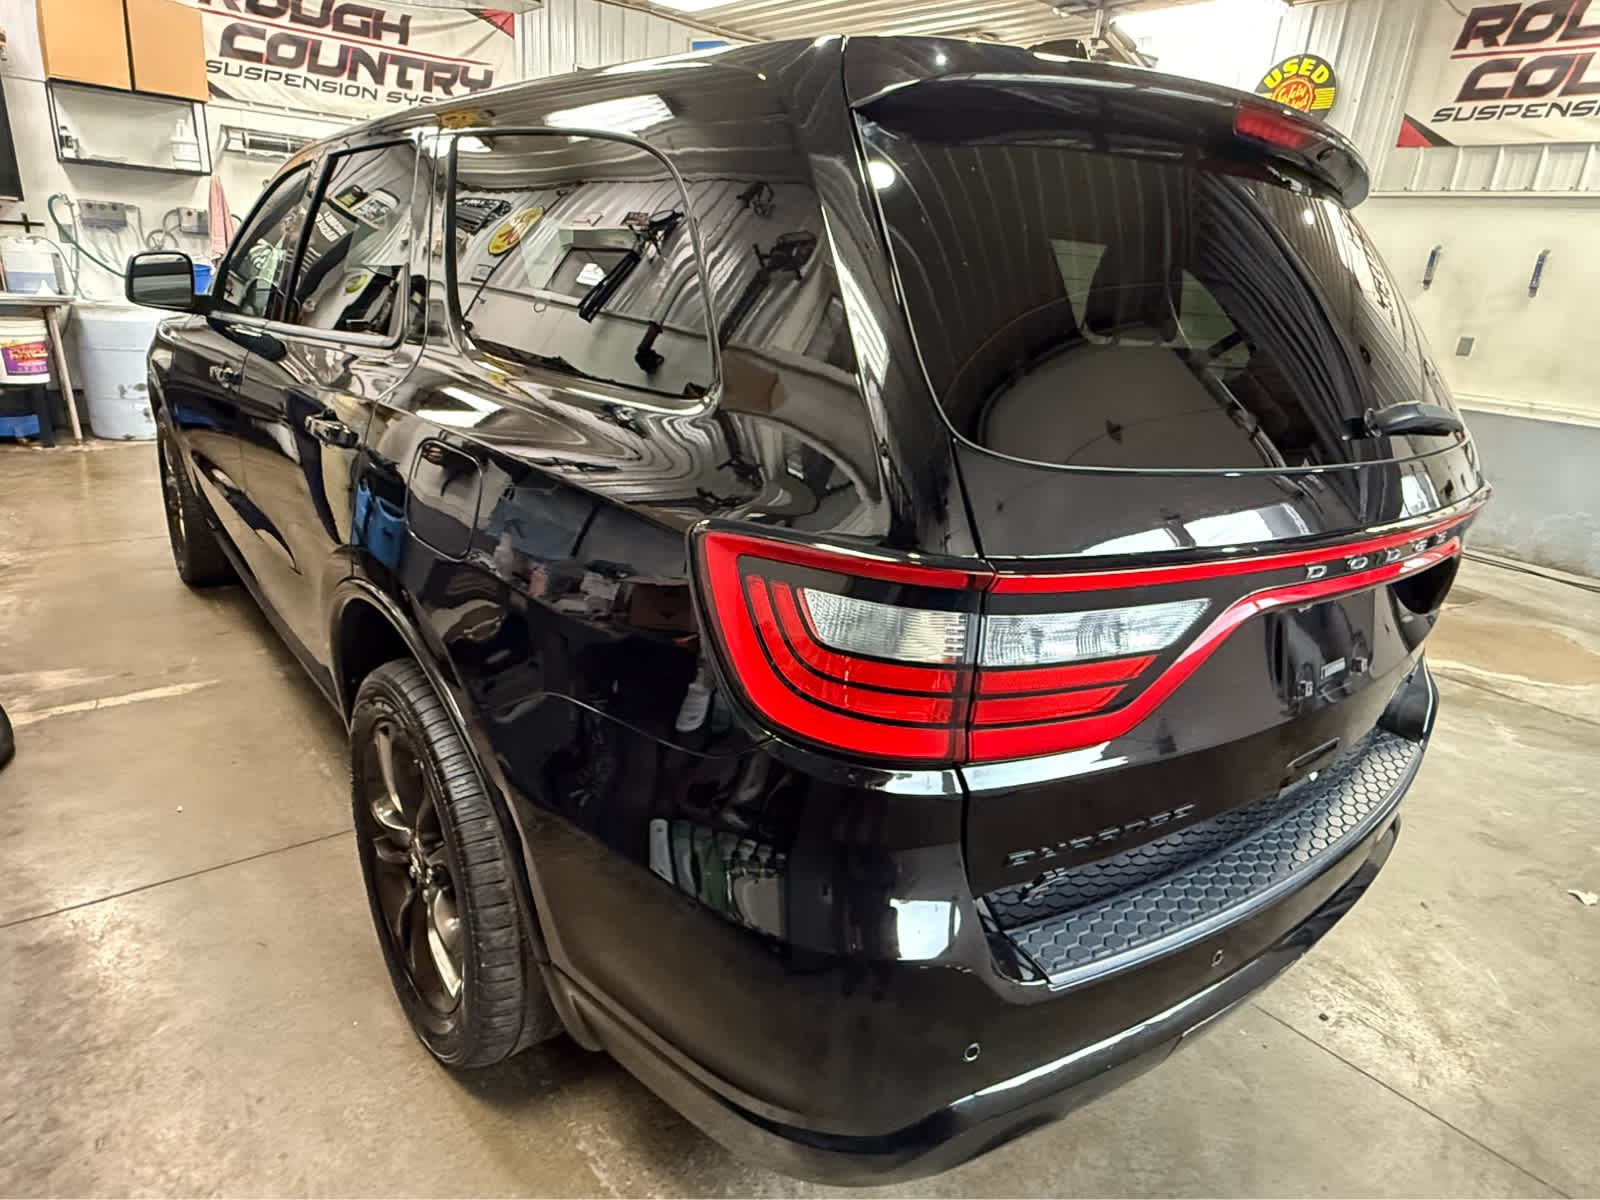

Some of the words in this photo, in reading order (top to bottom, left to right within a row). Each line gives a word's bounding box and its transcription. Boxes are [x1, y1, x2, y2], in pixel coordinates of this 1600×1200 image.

[206, 59, 378, 101] SUSPENSION
[386, 91, 445, 106] SYS
[219, 22, 494, 96] COUNTRY
[1263, 57, 1330, 89] USED
[1305, 530, 1448, 580] DODGE
